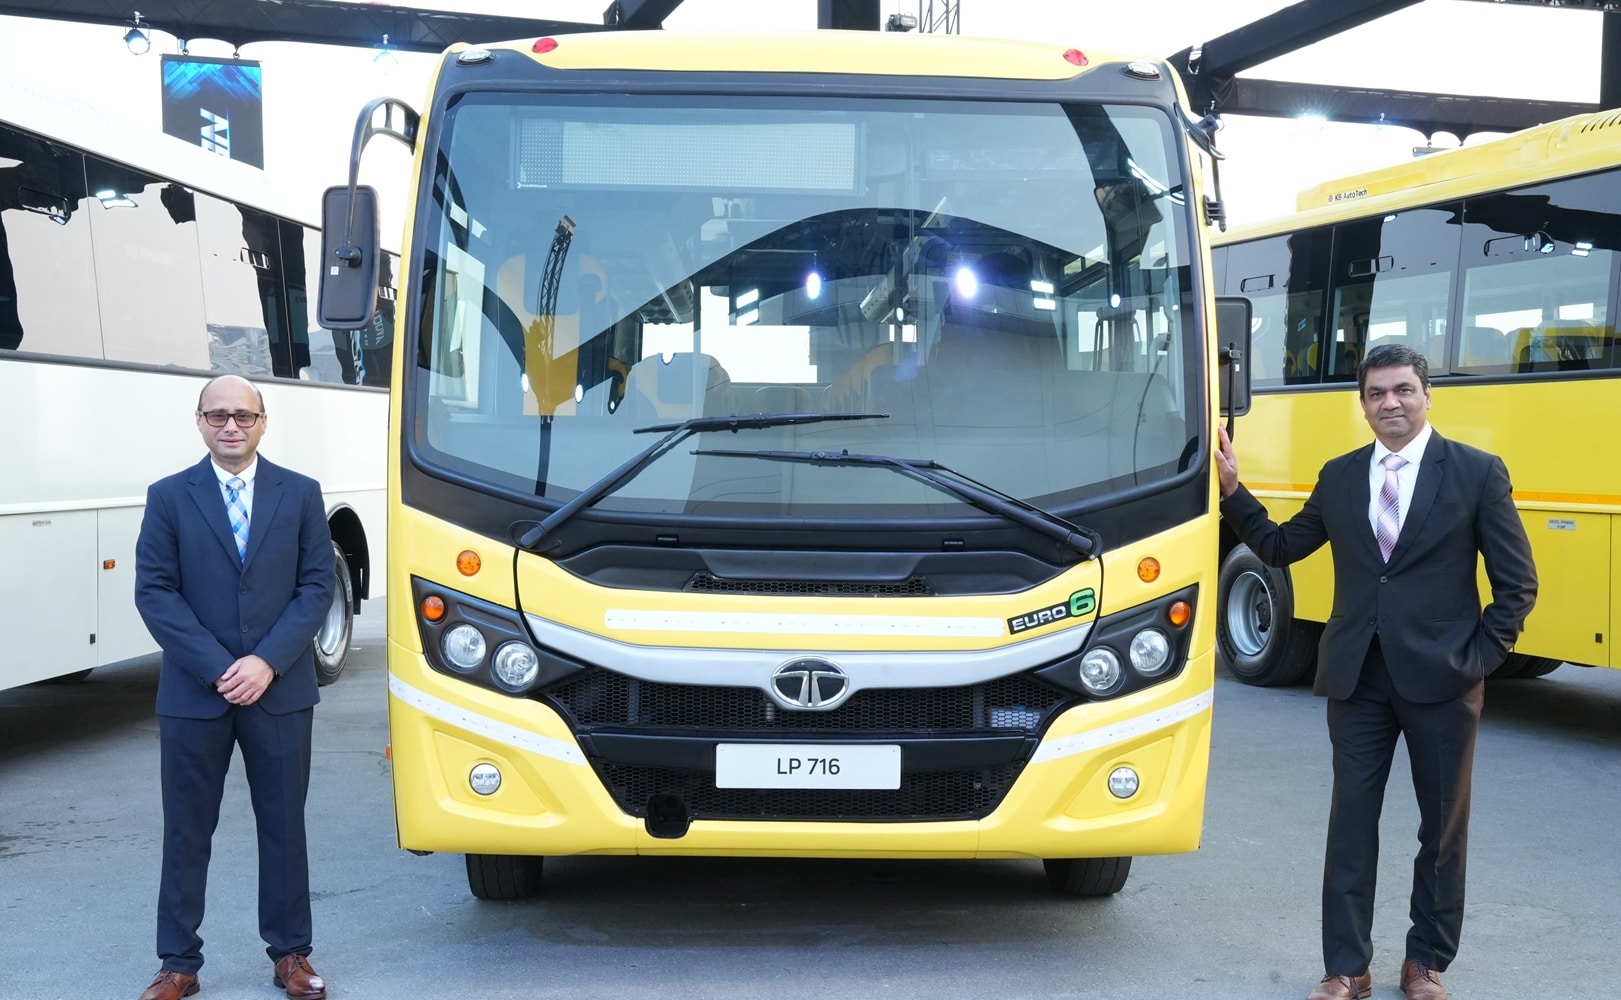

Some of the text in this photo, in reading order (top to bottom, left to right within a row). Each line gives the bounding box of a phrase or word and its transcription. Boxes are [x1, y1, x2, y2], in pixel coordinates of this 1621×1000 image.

[1335, 188, 1367, 201] KB AutoTech
[1011, 587, 1096, 632] EURO 6
[777, 757, 841, 775] LP 716
